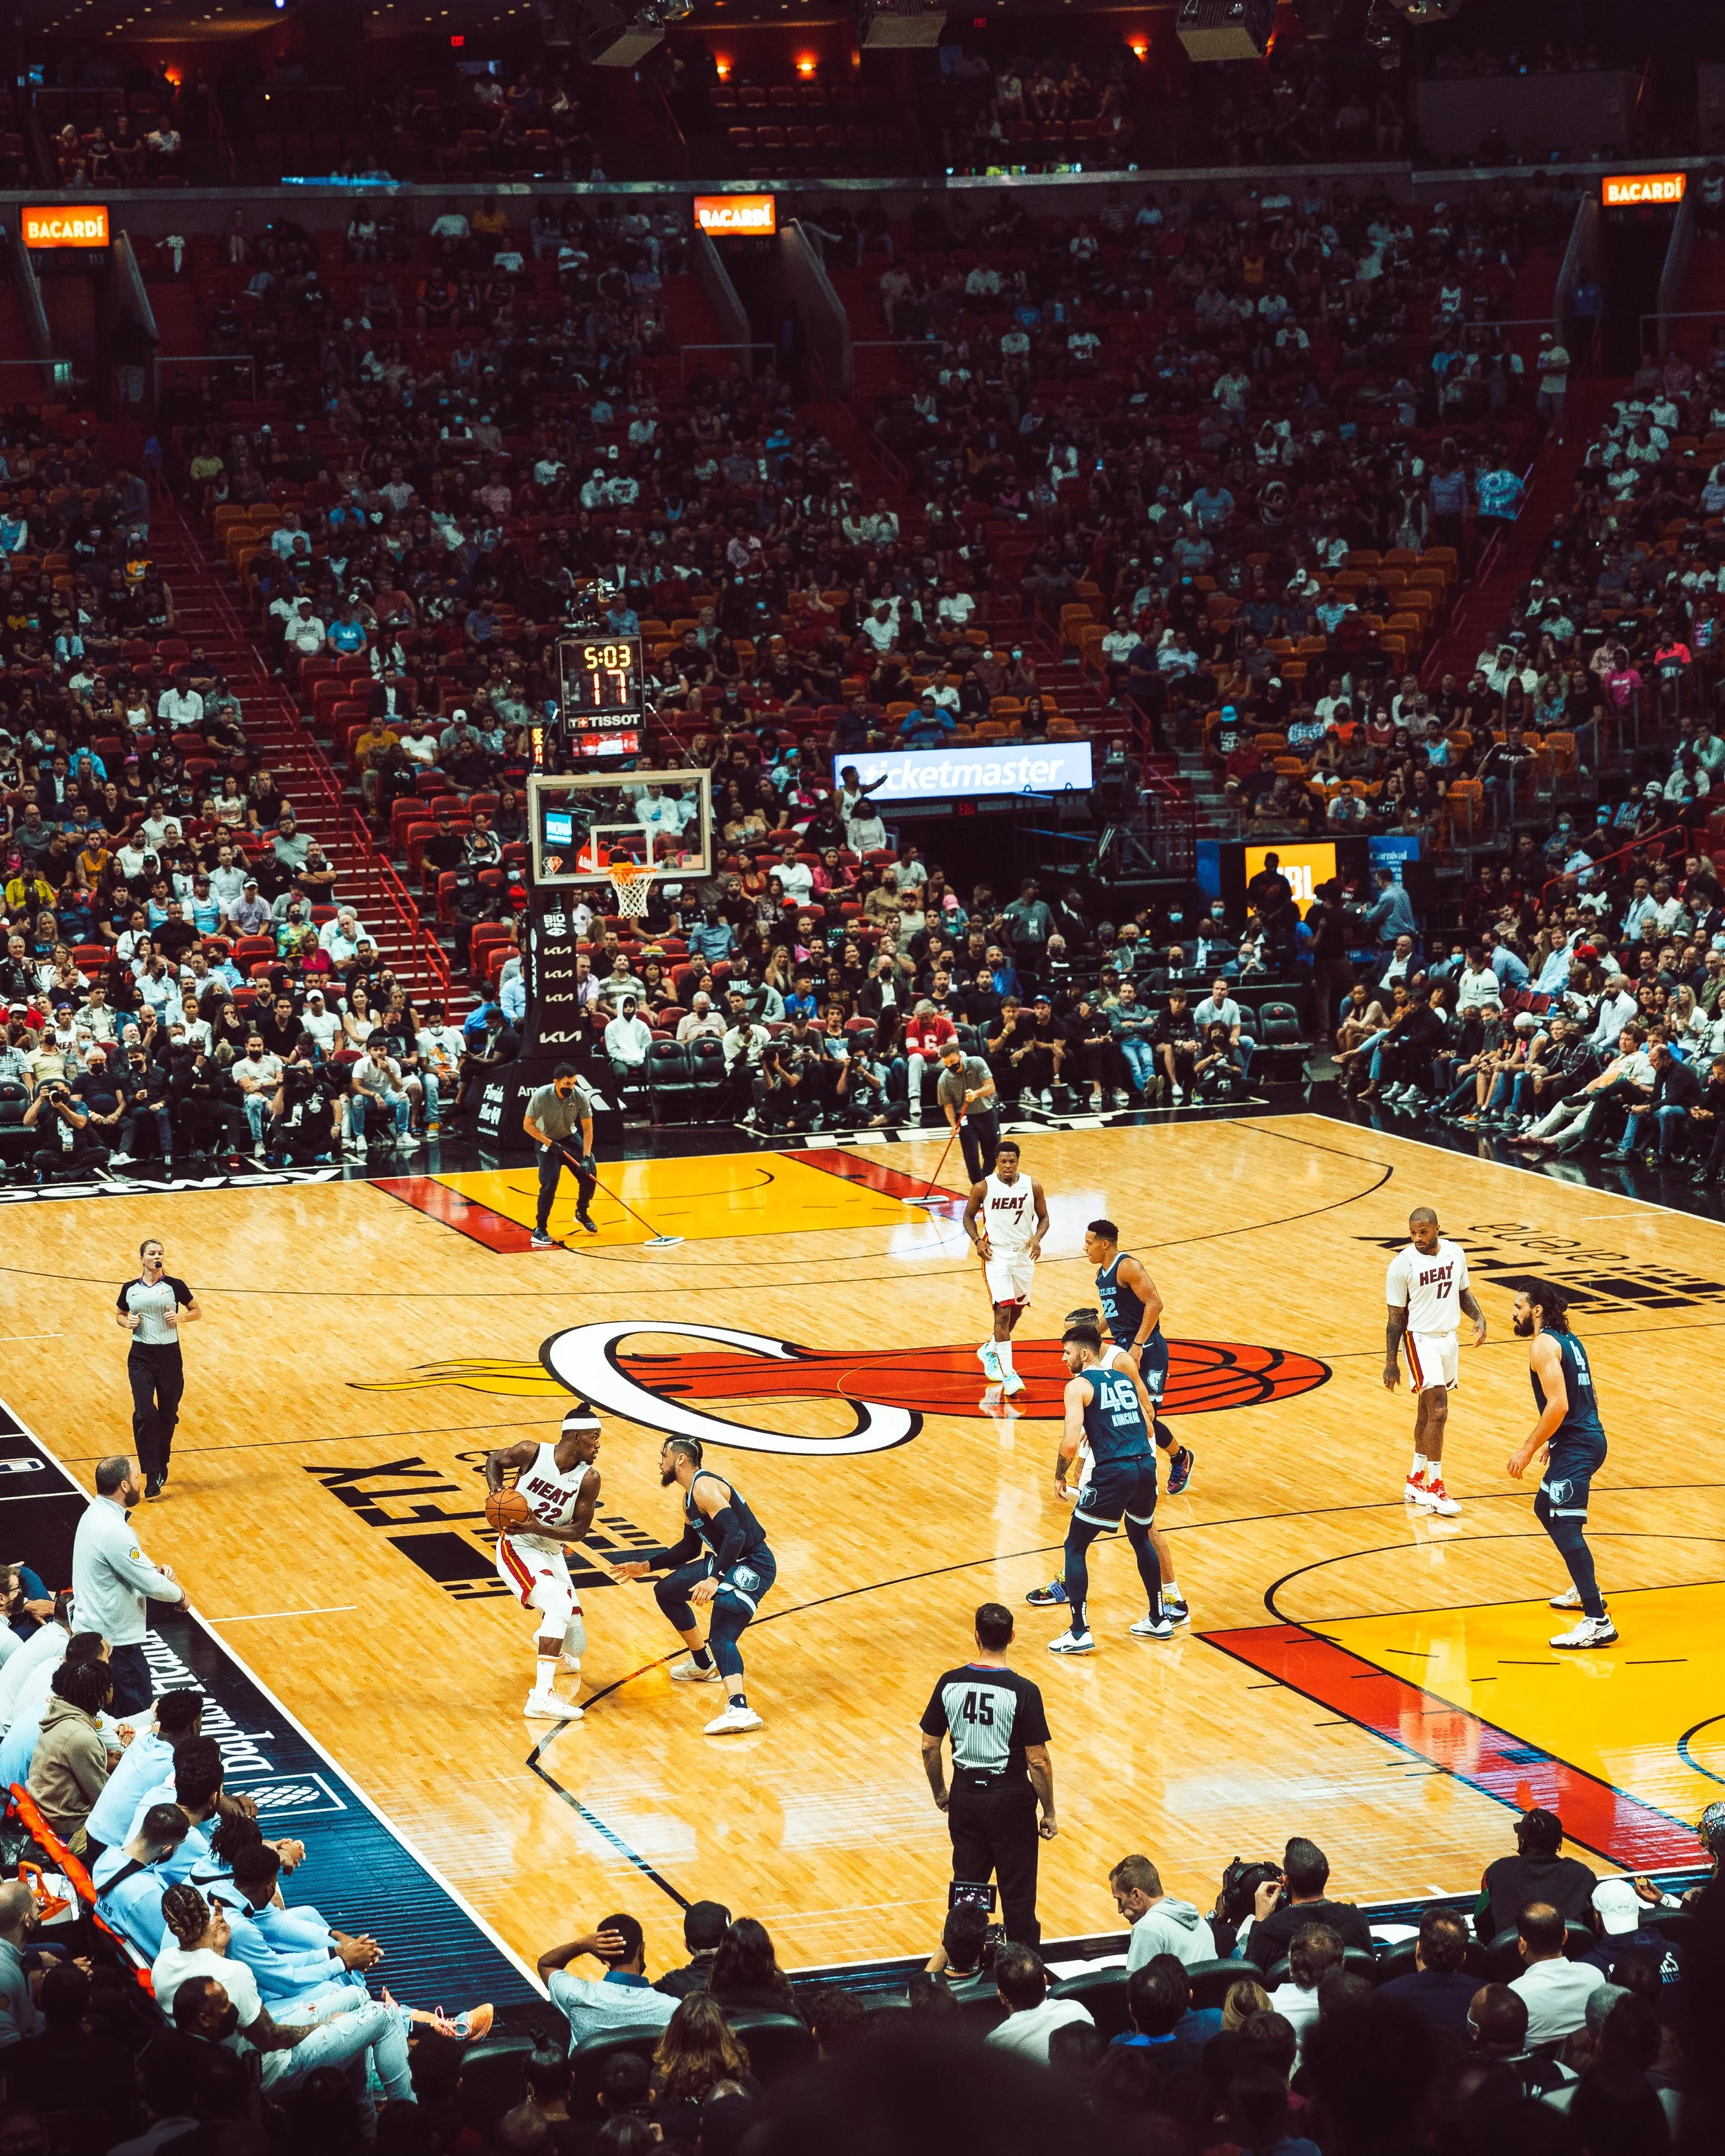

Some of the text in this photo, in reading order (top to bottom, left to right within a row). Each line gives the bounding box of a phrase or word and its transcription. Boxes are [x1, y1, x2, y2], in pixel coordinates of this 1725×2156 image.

[1608, 175, 1682, 202] BACARDÍ
[27, 215, 104, 239] BACARDÍ
[584, 644, 631, 669] 5:03
[593, 669, 627, 706] 17
[589, 713, 641, 726] TISSOT
[864, 758, 1065, 793] ticketmaster
[1276, 865, 1317, 901] BL
[543, 913, 566, 923] BIO
[991, 1193, 1028, 1209] HEAT
[1014, 1211, 1023, 1225] 7
[1419, 1260, 1454, 1287] HEAT
[1437, 1281, 1452, 1299] 17
[1569, 1341, 1586, 1371] 4
[1100, 1379, 1138, 1412] 46
[526, 1477, 578, 1507] HEAT
[533, 1502, 562, 1525] 22
[963, 1691, 995, 1726] 45
